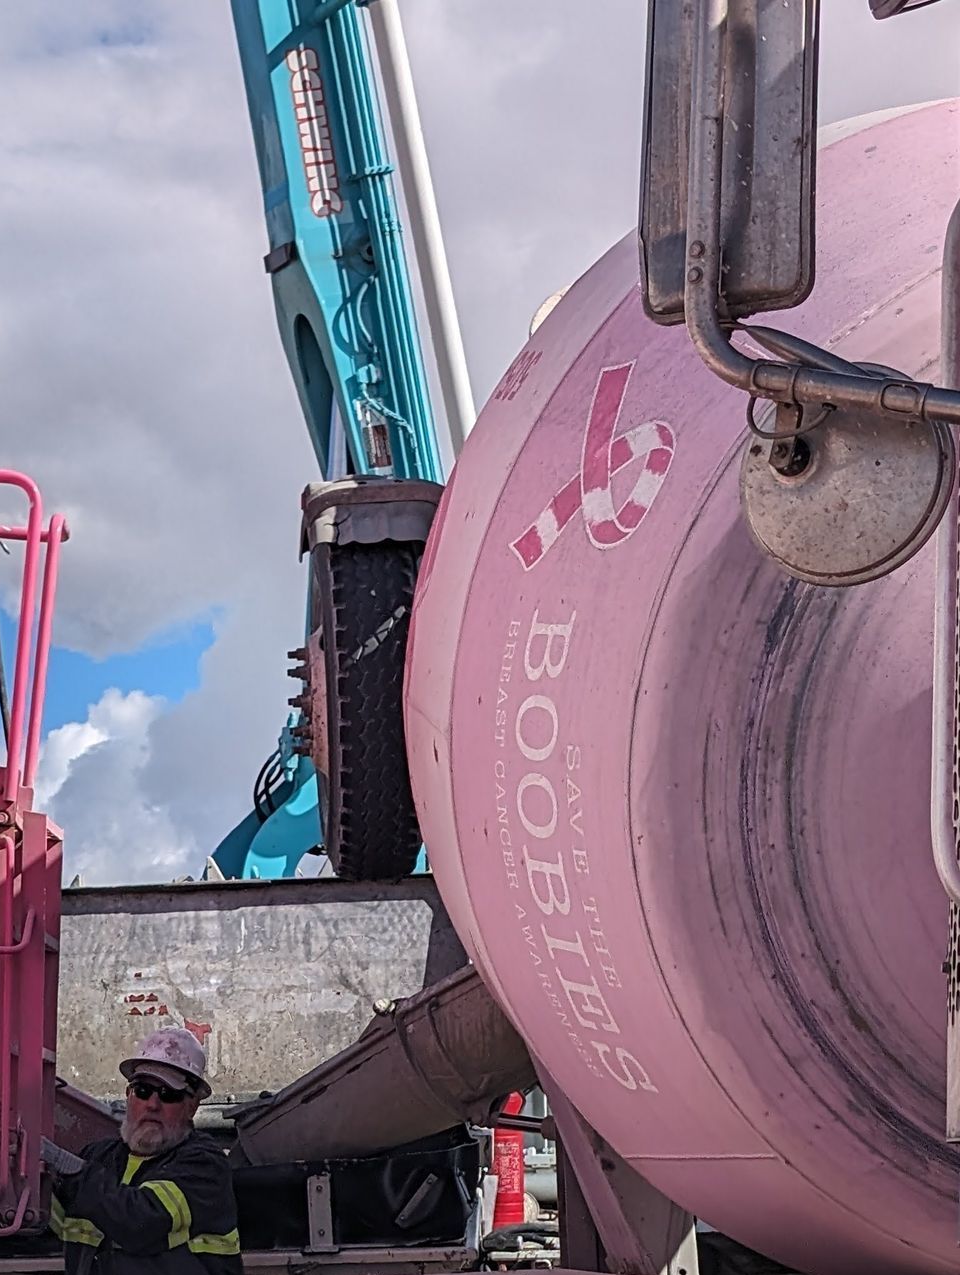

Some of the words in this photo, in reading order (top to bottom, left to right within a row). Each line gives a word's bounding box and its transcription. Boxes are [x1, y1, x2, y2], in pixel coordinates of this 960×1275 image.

[286, 48, 343, 218] SCHWING
[494, 620, 521, 748] BREAST
[494, 760, 519, 889] CANCER
[515, 608, 659, 1094] BOOBIES
[566, 744, 590, 876] SAVE
[581, 896, 623, 989] THE
[515, 903, 605, 1079] AWARENESS
